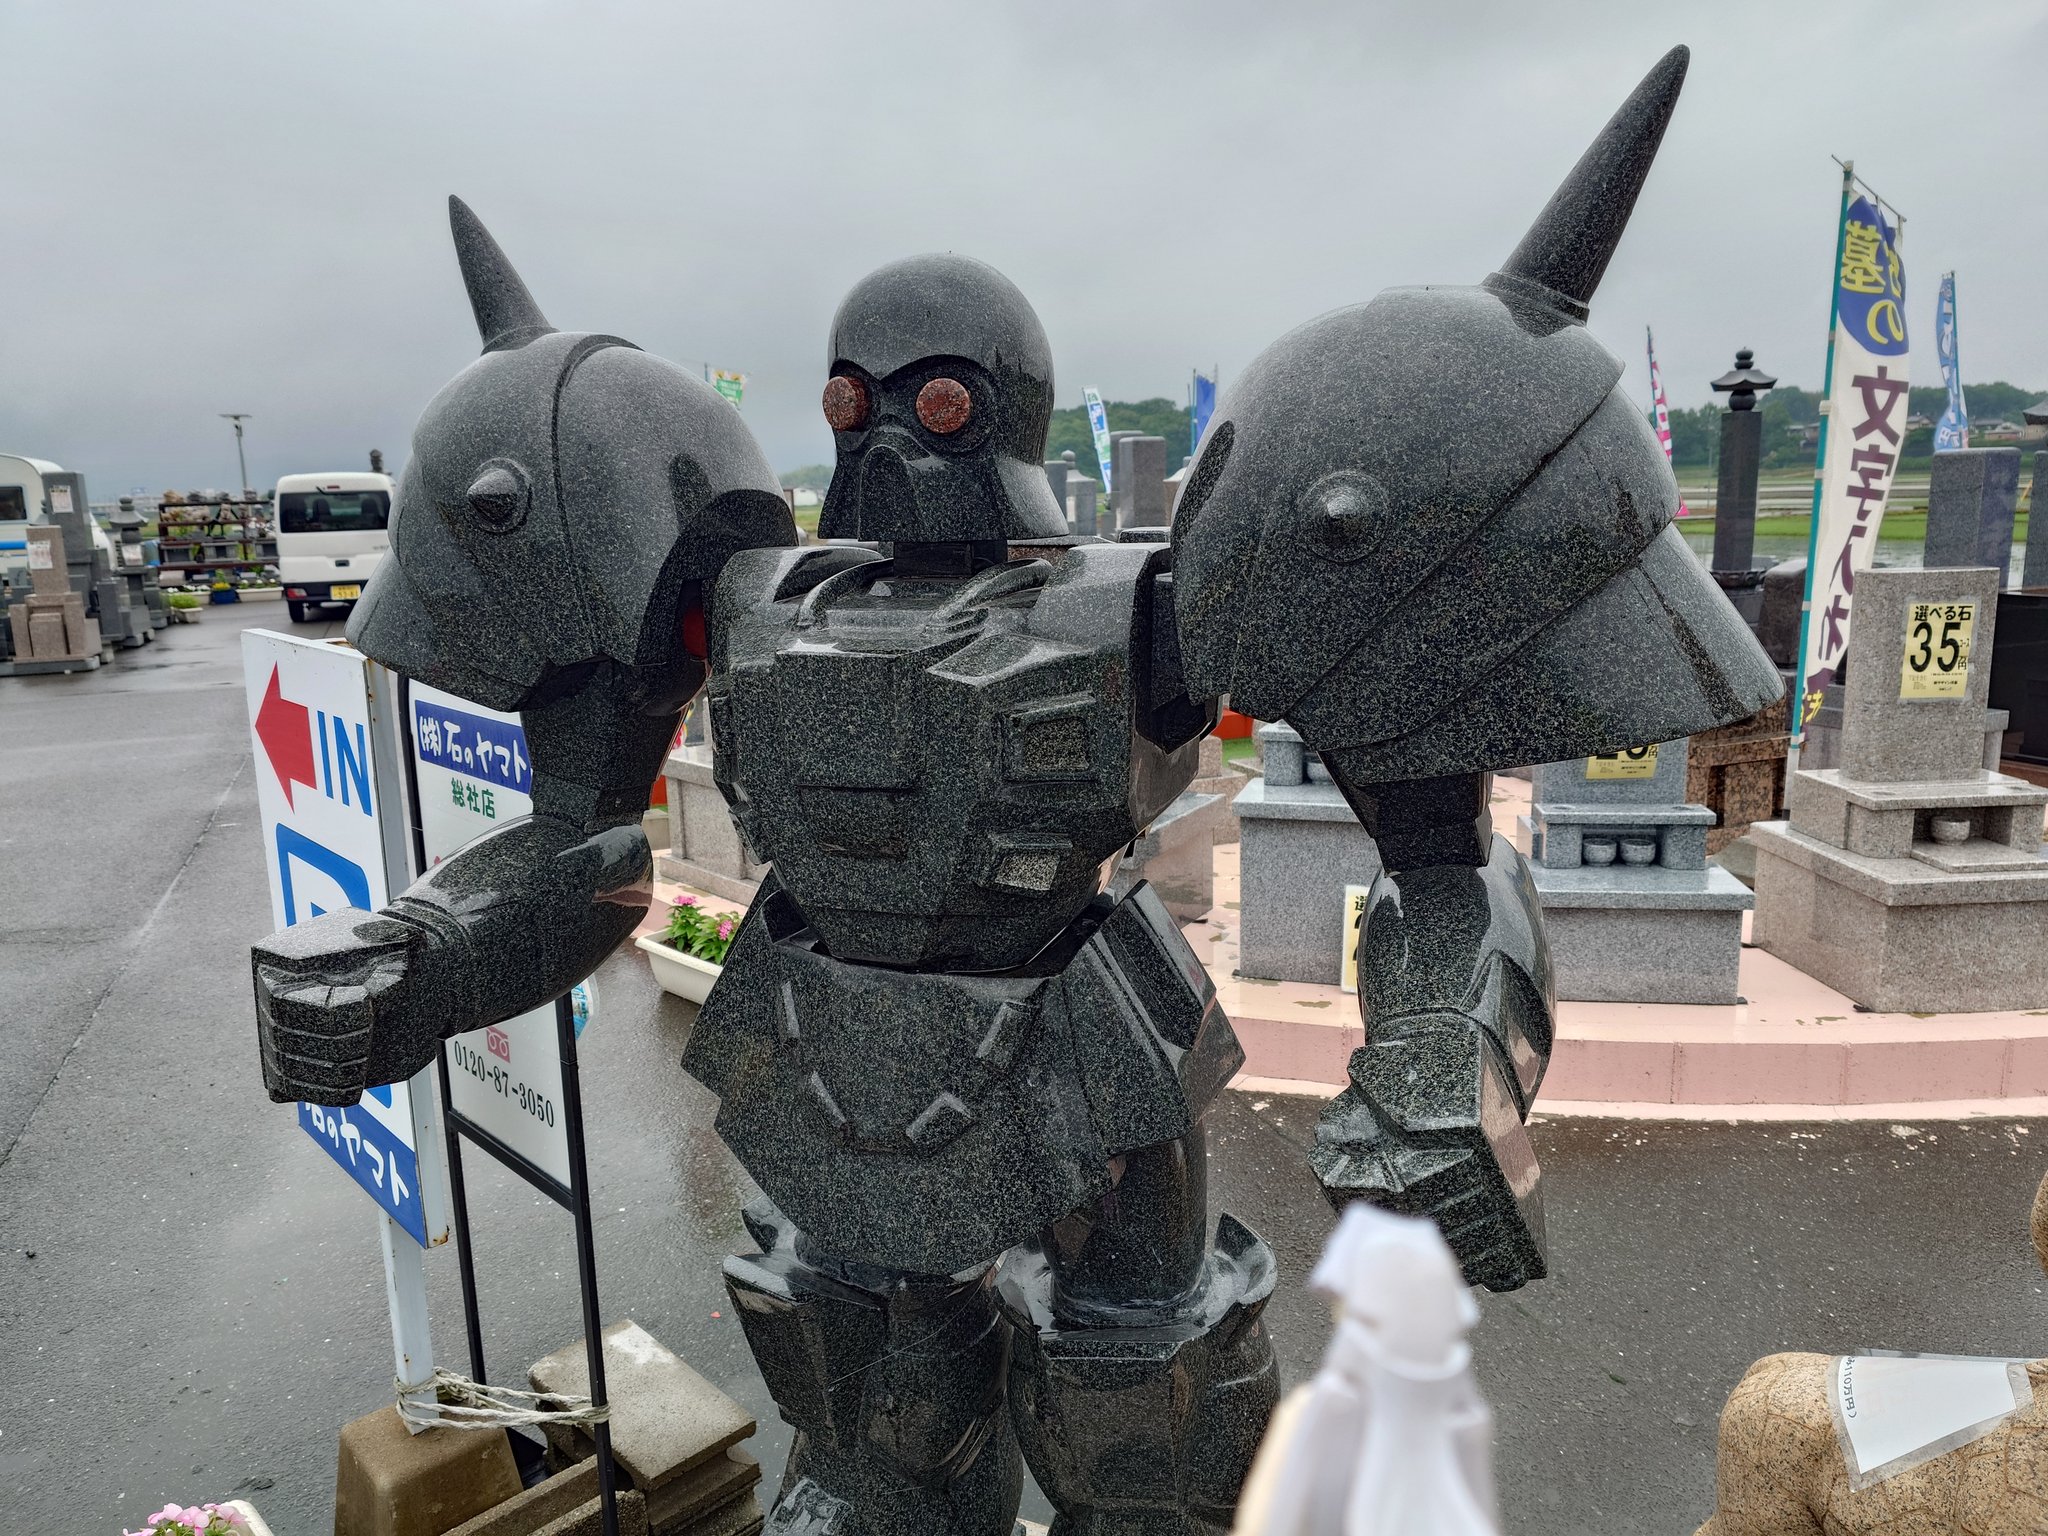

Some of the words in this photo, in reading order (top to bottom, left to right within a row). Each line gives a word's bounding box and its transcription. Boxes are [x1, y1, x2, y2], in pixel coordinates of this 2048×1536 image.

[1914, 605, 1973, 622] 選べる石
[1909, 621, 1962, 673] 35
[317, 709, 373, 817] IN
[451, 777, 495, 819] 総社店
[454, 1041, 554, 1128] 0120-87-3050
